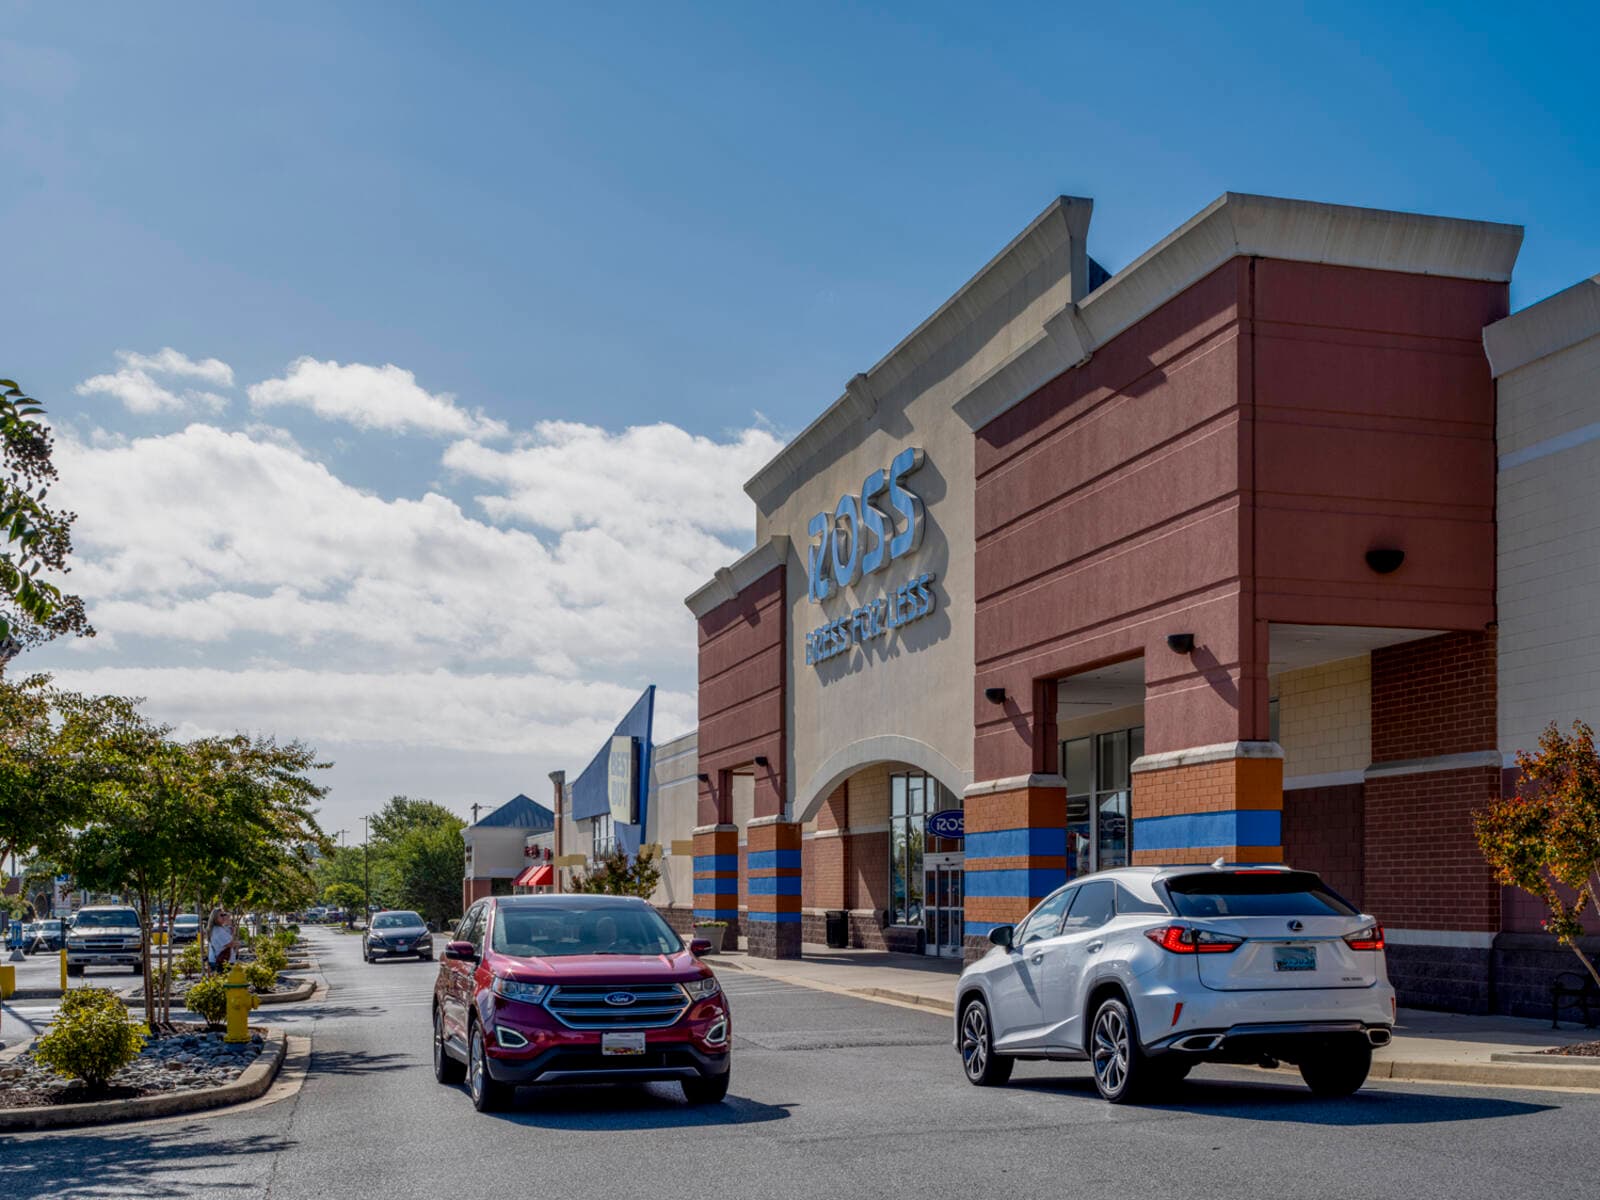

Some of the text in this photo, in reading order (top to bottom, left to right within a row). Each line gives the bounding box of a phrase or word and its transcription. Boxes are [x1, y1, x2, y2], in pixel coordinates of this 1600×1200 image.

[807, 446, 925, 605] ROSS
[805, 572, 936, 666] DRESS FOR LESS
[610, 777, 629, 808] BUY
[936, 817, 964, 832] ROS
[611, 994, 629, 1003] Ford
